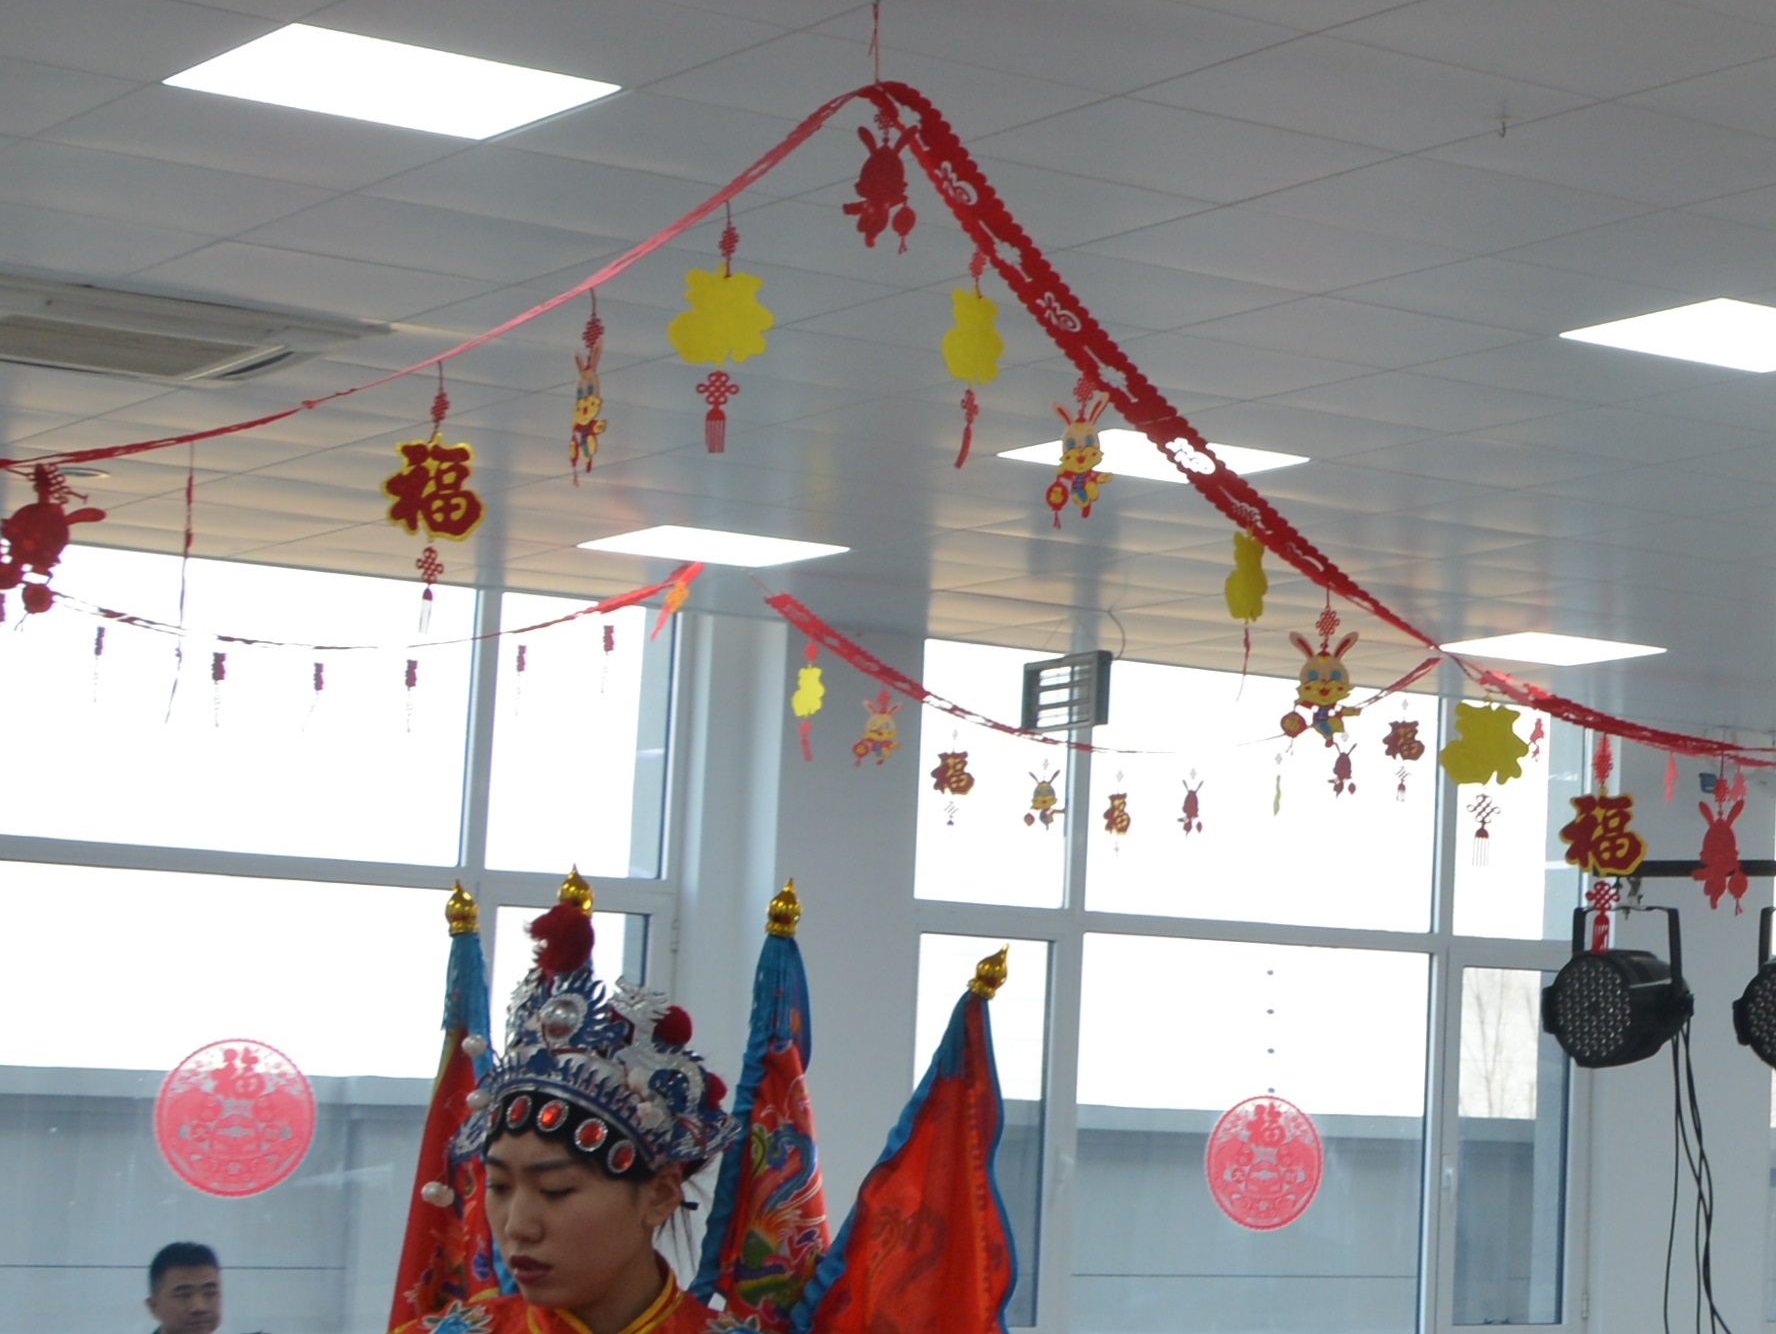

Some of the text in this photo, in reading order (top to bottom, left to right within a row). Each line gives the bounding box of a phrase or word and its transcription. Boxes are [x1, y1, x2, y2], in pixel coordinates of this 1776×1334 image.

[385, 442, 483, 537] 福
[1382, 720, 1425, 760] 福
[931, 751, 974, 795] 福
[1103, 793, 1131, 834] 福
[1560, 792, 1645, 873] 福
[210, 1048, 265, 1100] 福
[1246, 1101, 1287, 1147] 福
